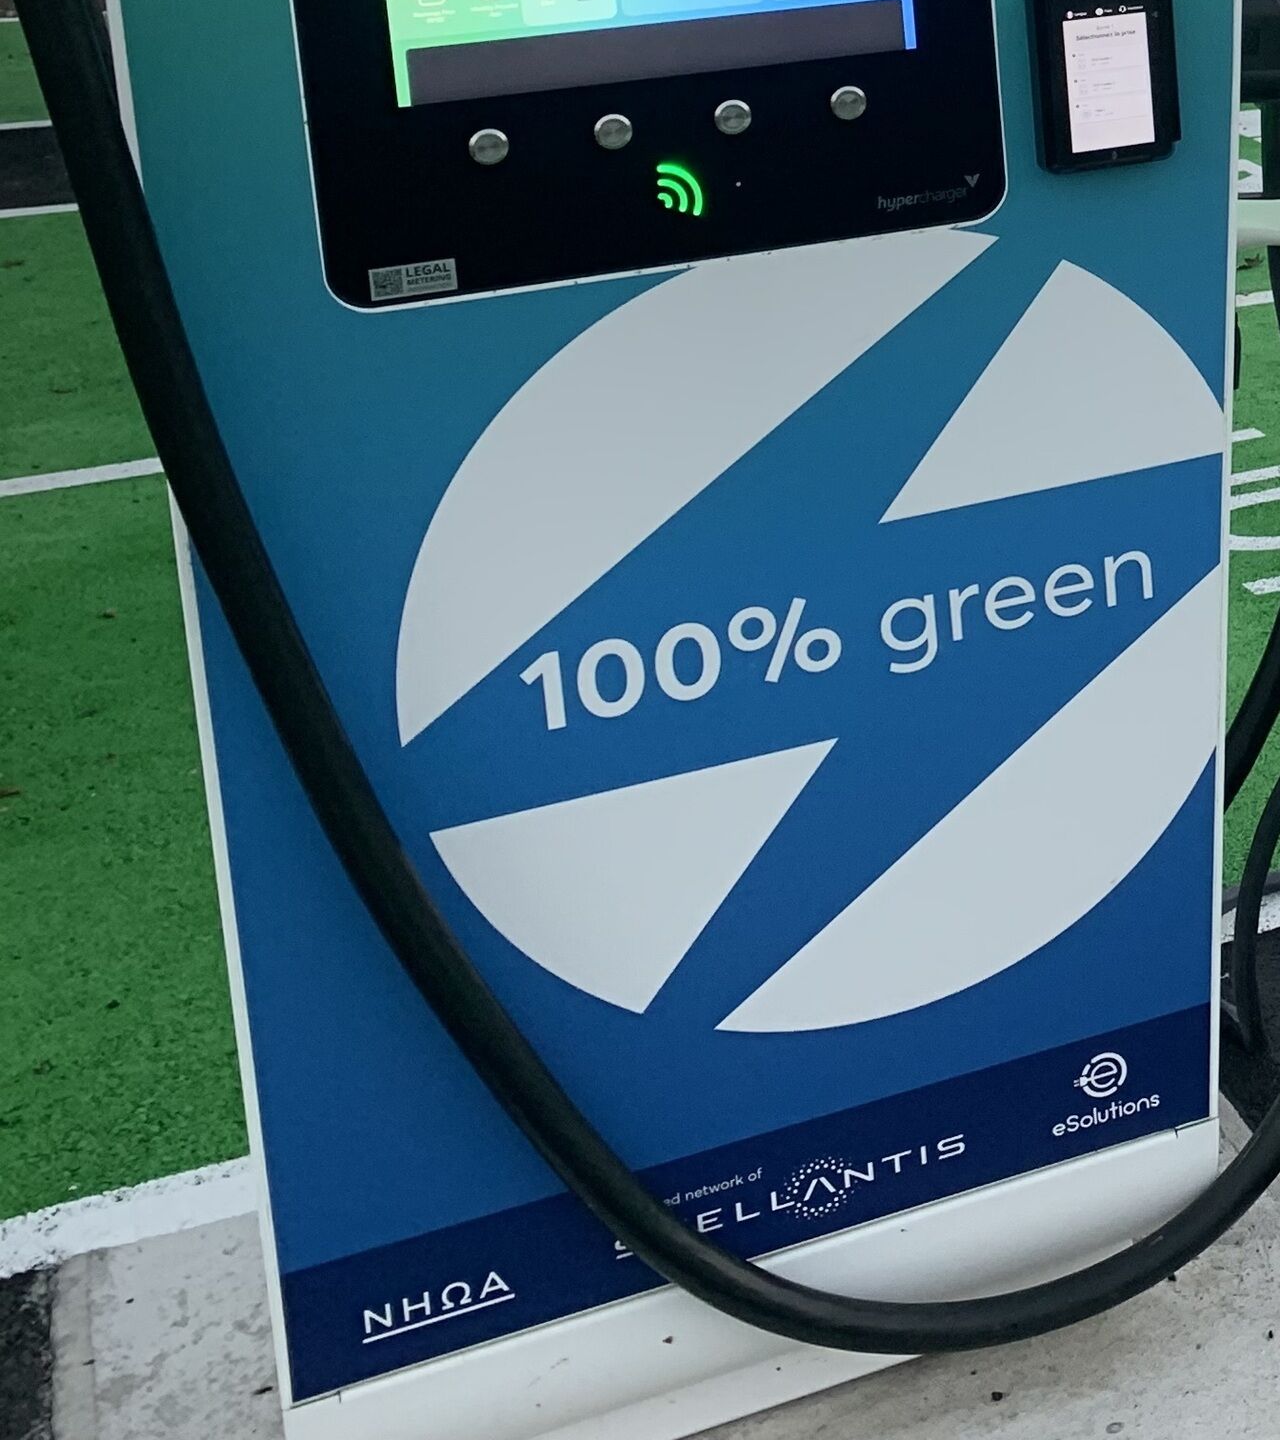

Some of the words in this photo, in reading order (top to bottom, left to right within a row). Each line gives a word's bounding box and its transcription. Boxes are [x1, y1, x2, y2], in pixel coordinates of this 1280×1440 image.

[877, 186, 968, 212] hypercharger
[405, 262, 451, 278] LEGAL
[407, 274, 452, 285] METERING
[519, 594, 843, 732] 100%
[879, 547, 1155, 675] green
[1052, 1094, 1160, 1137] eSolutions
[684, 1174, 744, 1201] network
[748, 1166, 763, 1181] of
